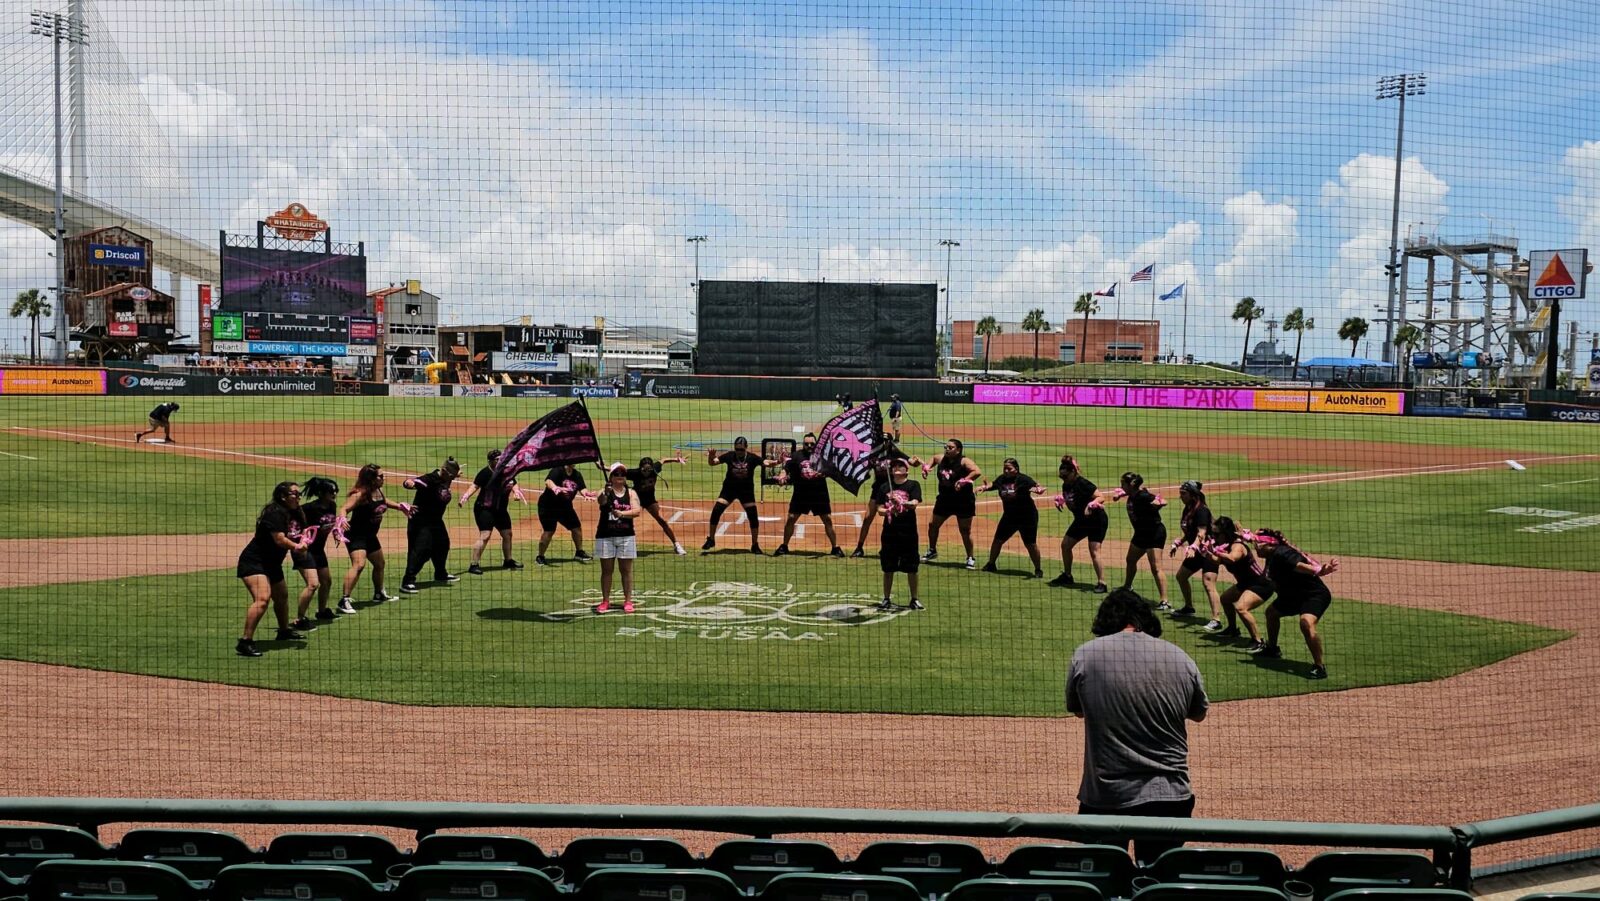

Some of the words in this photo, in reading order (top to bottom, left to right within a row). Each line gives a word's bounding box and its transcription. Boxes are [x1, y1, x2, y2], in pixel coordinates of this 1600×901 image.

[105, 250, 140, 260] Driscoll
[1534, 286, 1575, 297] CITGO
[538, 328, 561, 337] FLINT
[562, 329, 584, 338] HILLS
[215, 343, 240, 351] reliant
[252, 343, 295, 352] POWERING
[302, 344, 316, 352] THE
[317, 345, 345, 353] HOOKS
[505, 352, 558, 361] CHENIERE
[234, 380, 316, 391] churchunlimited
[1031, 386, 1078, 405] PINK
[1092, 387, 1117, 405] IN
[1130, 388, 1169, 406] THE
[1183, 389, 1239, 409] PARK
[1325, 393, 1386, 405] AutoNation
[698, 630, 824, 641] USAA
